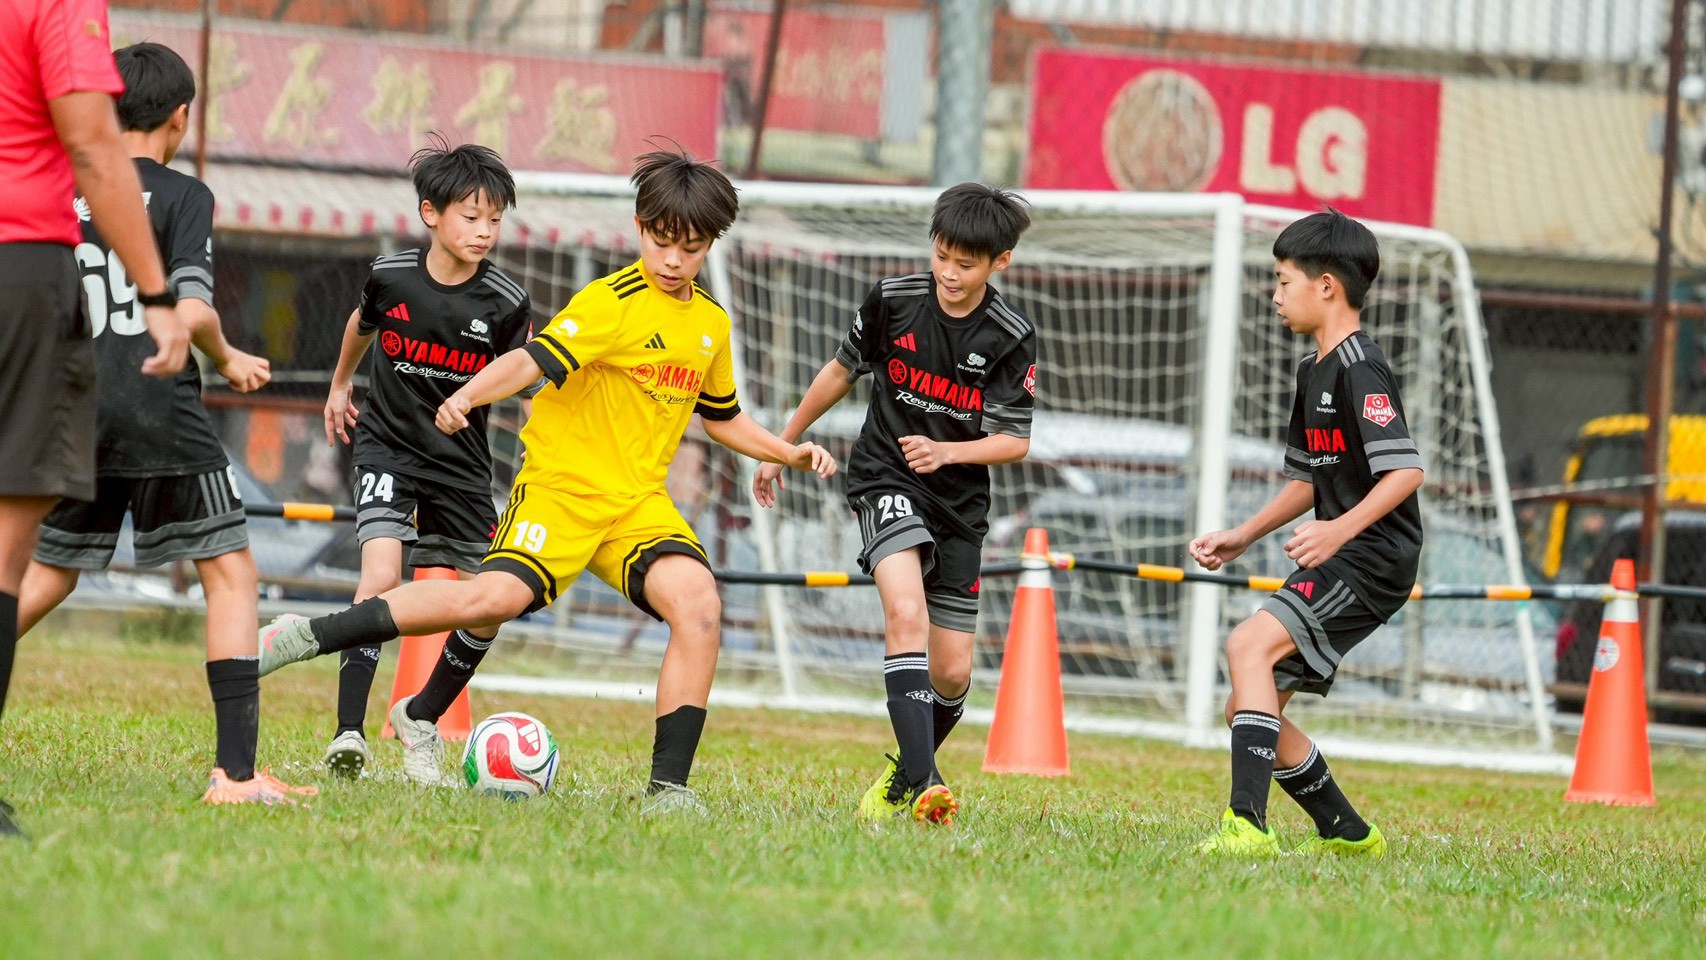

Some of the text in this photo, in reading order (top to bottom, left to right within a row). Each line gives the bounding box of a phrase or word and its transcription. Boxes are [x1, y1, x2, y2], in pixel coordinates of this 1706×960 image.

[1241, 102, 1367, 200] LG
[405, 338, 487, 373] YAMAHA
[656, 365, 704, 393] YAMAH
[909, 367, 982, 411] YAMAHA
[896, 389, 973, 420] Revs Your Heart
[360, 473, 394, 504] 24
[878, 494, 914, 524] 29
[513, 520, 547, 553] 19
